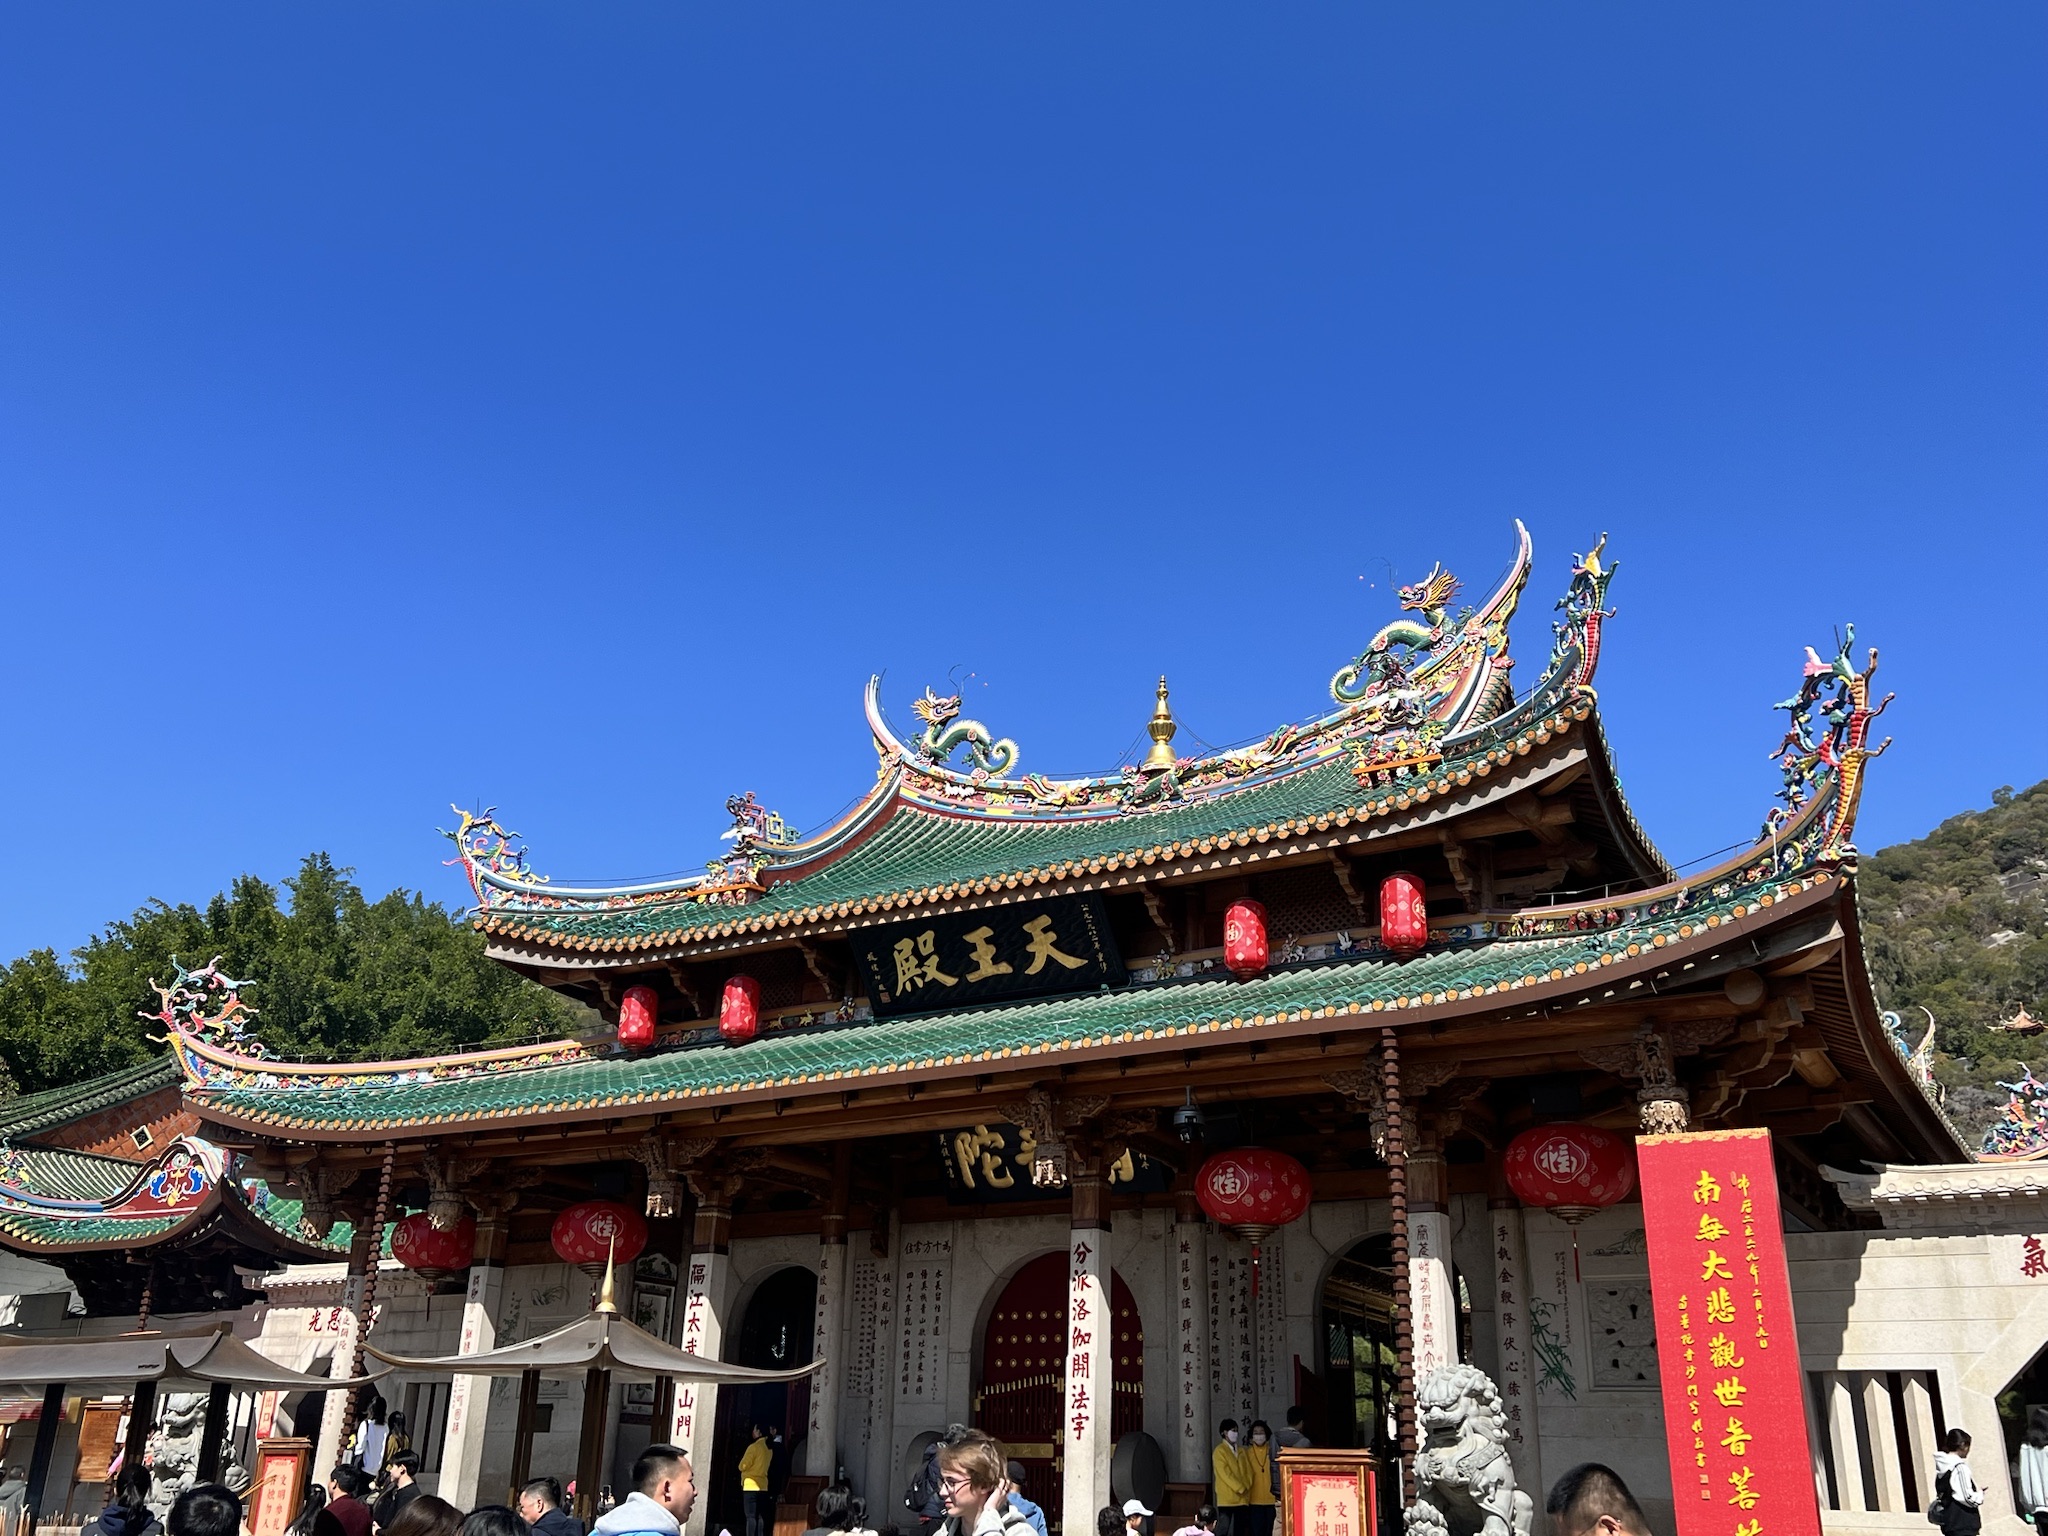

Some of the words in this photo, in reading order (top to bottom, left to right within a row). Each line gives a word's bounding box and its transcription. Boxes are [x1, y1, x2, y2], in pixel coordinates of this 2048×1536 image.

[894, 914, 1089, 997] 天王殿
[1540, 1143, 1578, 1174] 福
[1213, 1167, 1241, 1195] 福
[591, 1215, 618, 1238] 福
[2020, 1236, 2048, 1278] 氣
[676, 1263, 706, 1438] 隔江太武山門
[1072, 1241, 1093, 1440] 分派洛伽開法宇
[263, 1396, 273, 1422] 出口
[1313, 1501, 1329, 1536] 香烛
[1334, 1501, 1349, 1536] 文明
